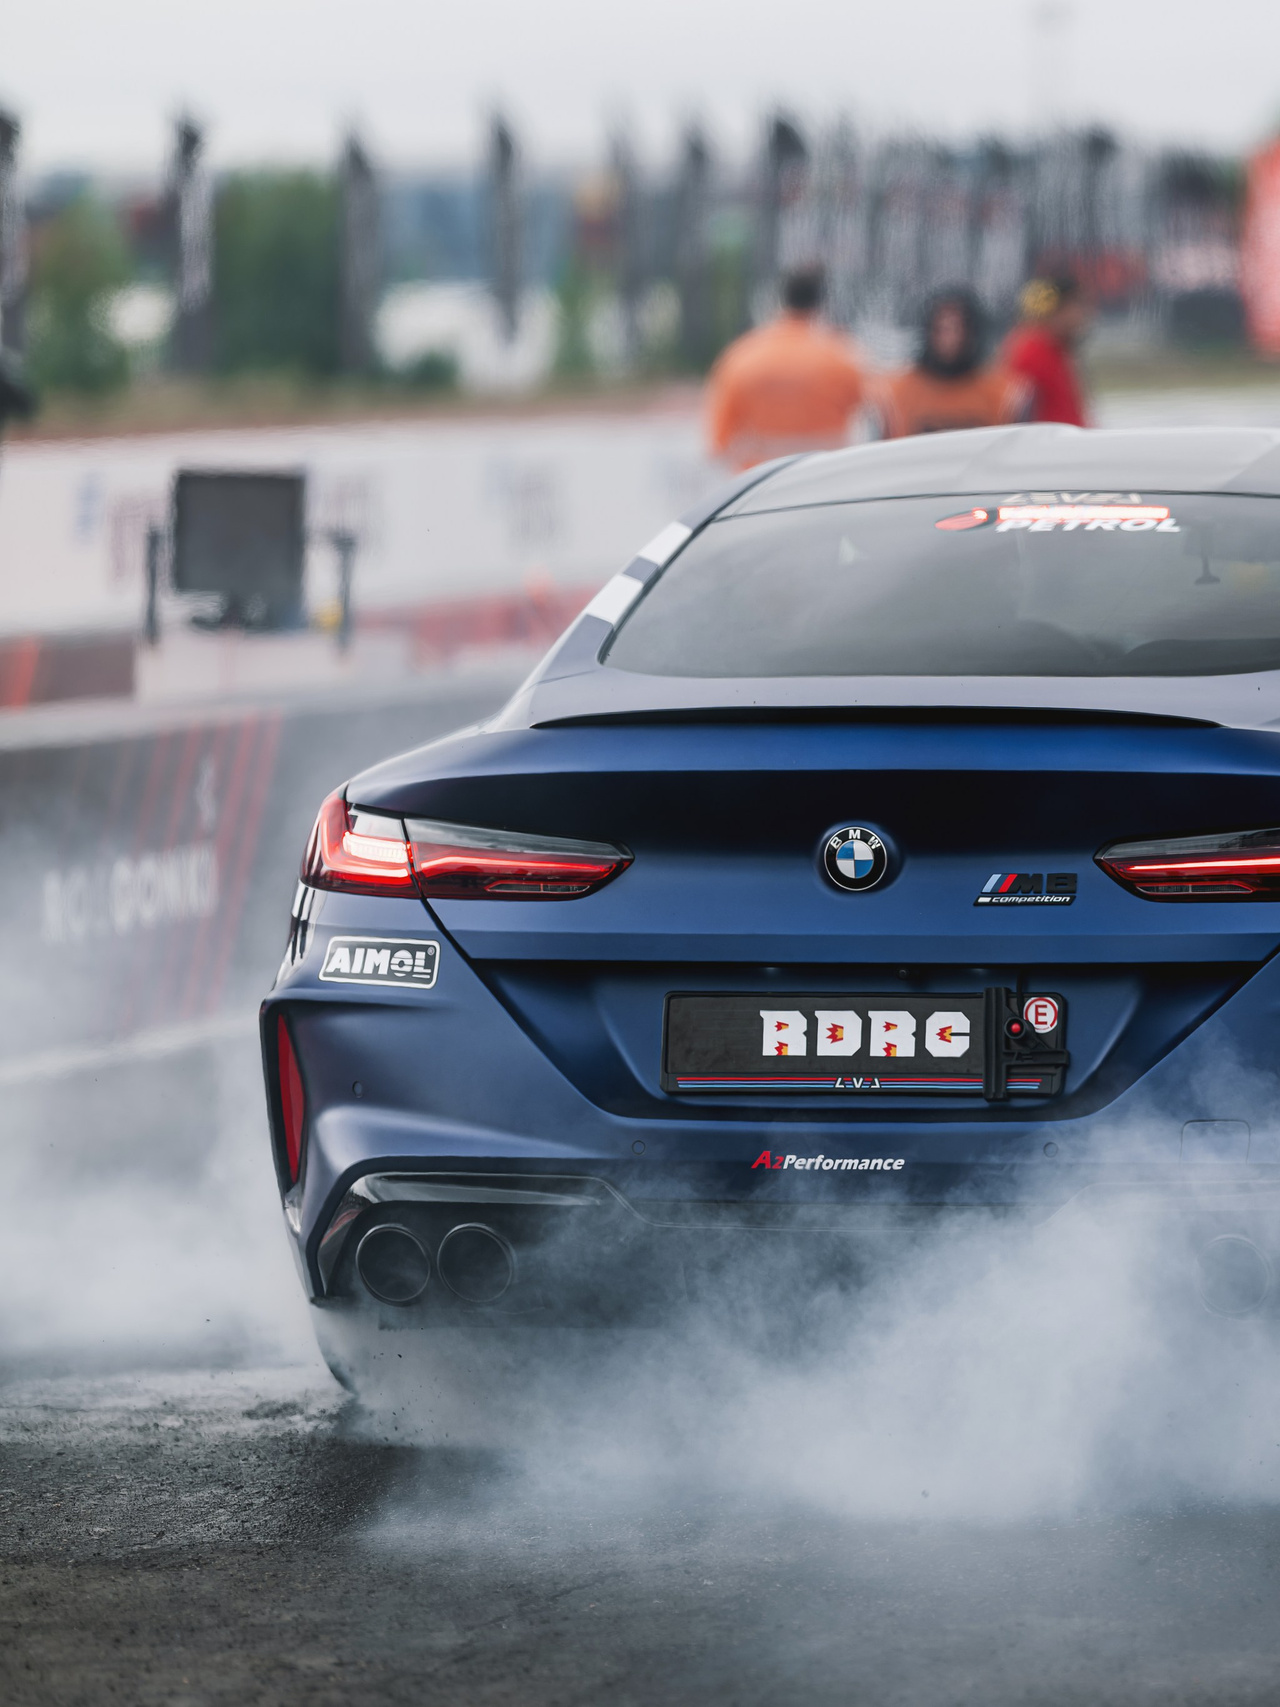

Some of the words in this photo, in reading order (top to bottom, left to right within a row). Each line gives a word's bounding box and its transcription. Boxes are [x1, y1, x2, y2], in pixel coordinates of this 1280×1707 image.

[997, 517, 1181, 533] PETROL
[830, 829, 882, 850] BMW
[991, 895, 1071, 905] competition
[1034, 1004, 1048, 1025] E
